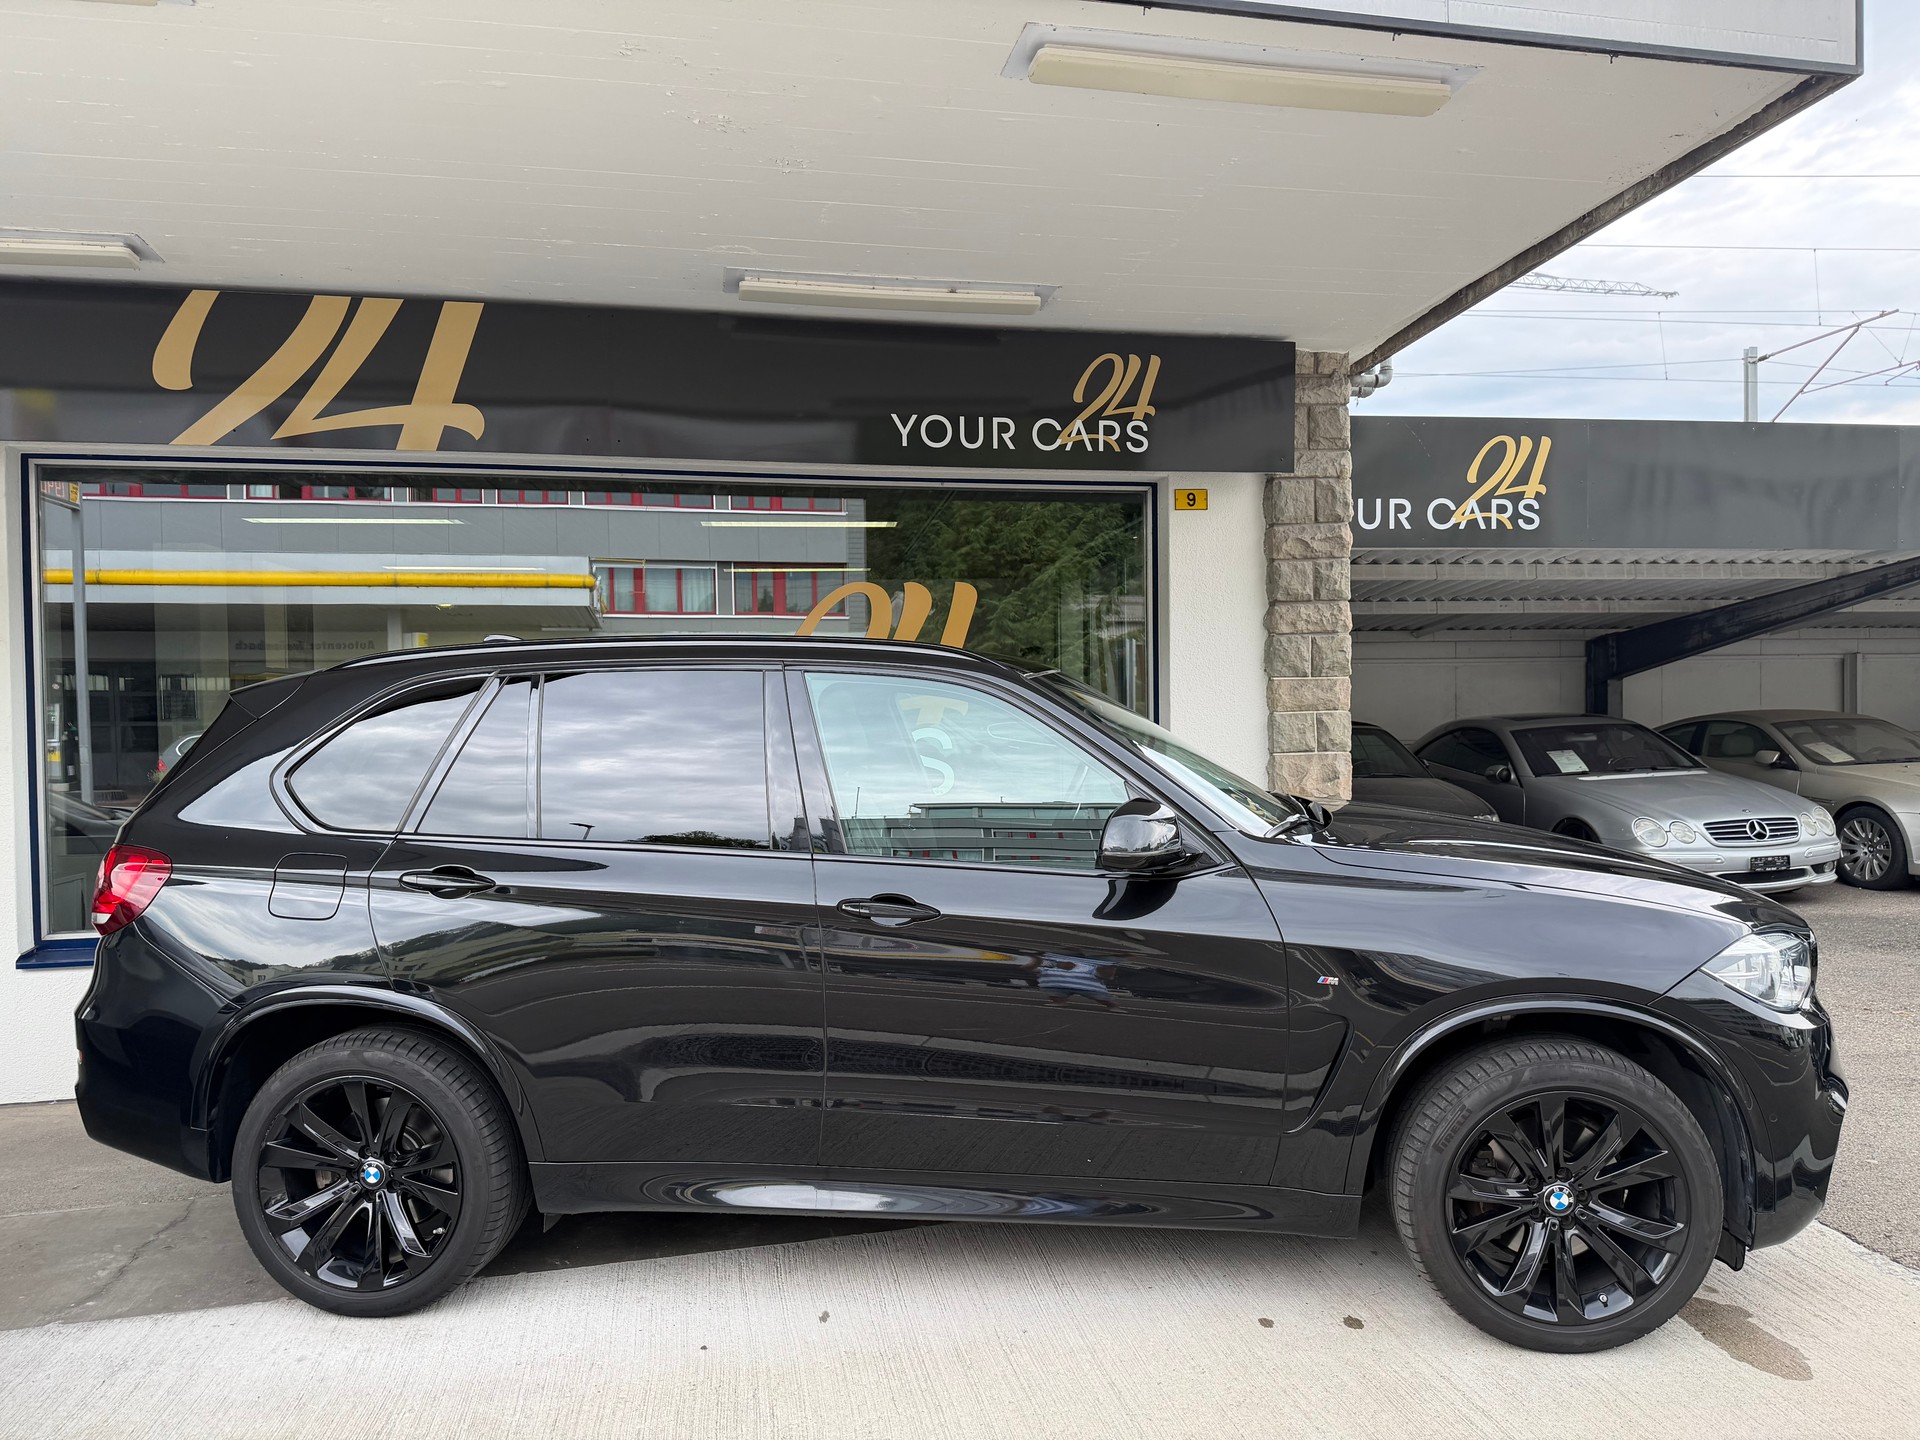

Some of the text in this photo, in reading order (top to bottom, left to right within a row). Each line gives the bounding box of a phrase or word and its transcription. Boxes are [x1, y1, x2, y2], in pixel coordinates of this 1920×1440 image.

[1059, 353, 1161, 452] 24
[890, 413, 1149, 453] YOUR CARS
[1187, 492, 1197, 507] 9
[1453, 435, 1552, 530] 24
[1357, 497, 1540, 530] UR CARS
[1431, 1104, 1472, 1153] PIRELLI
[1553, 1186, 1574, 1203] BMW
